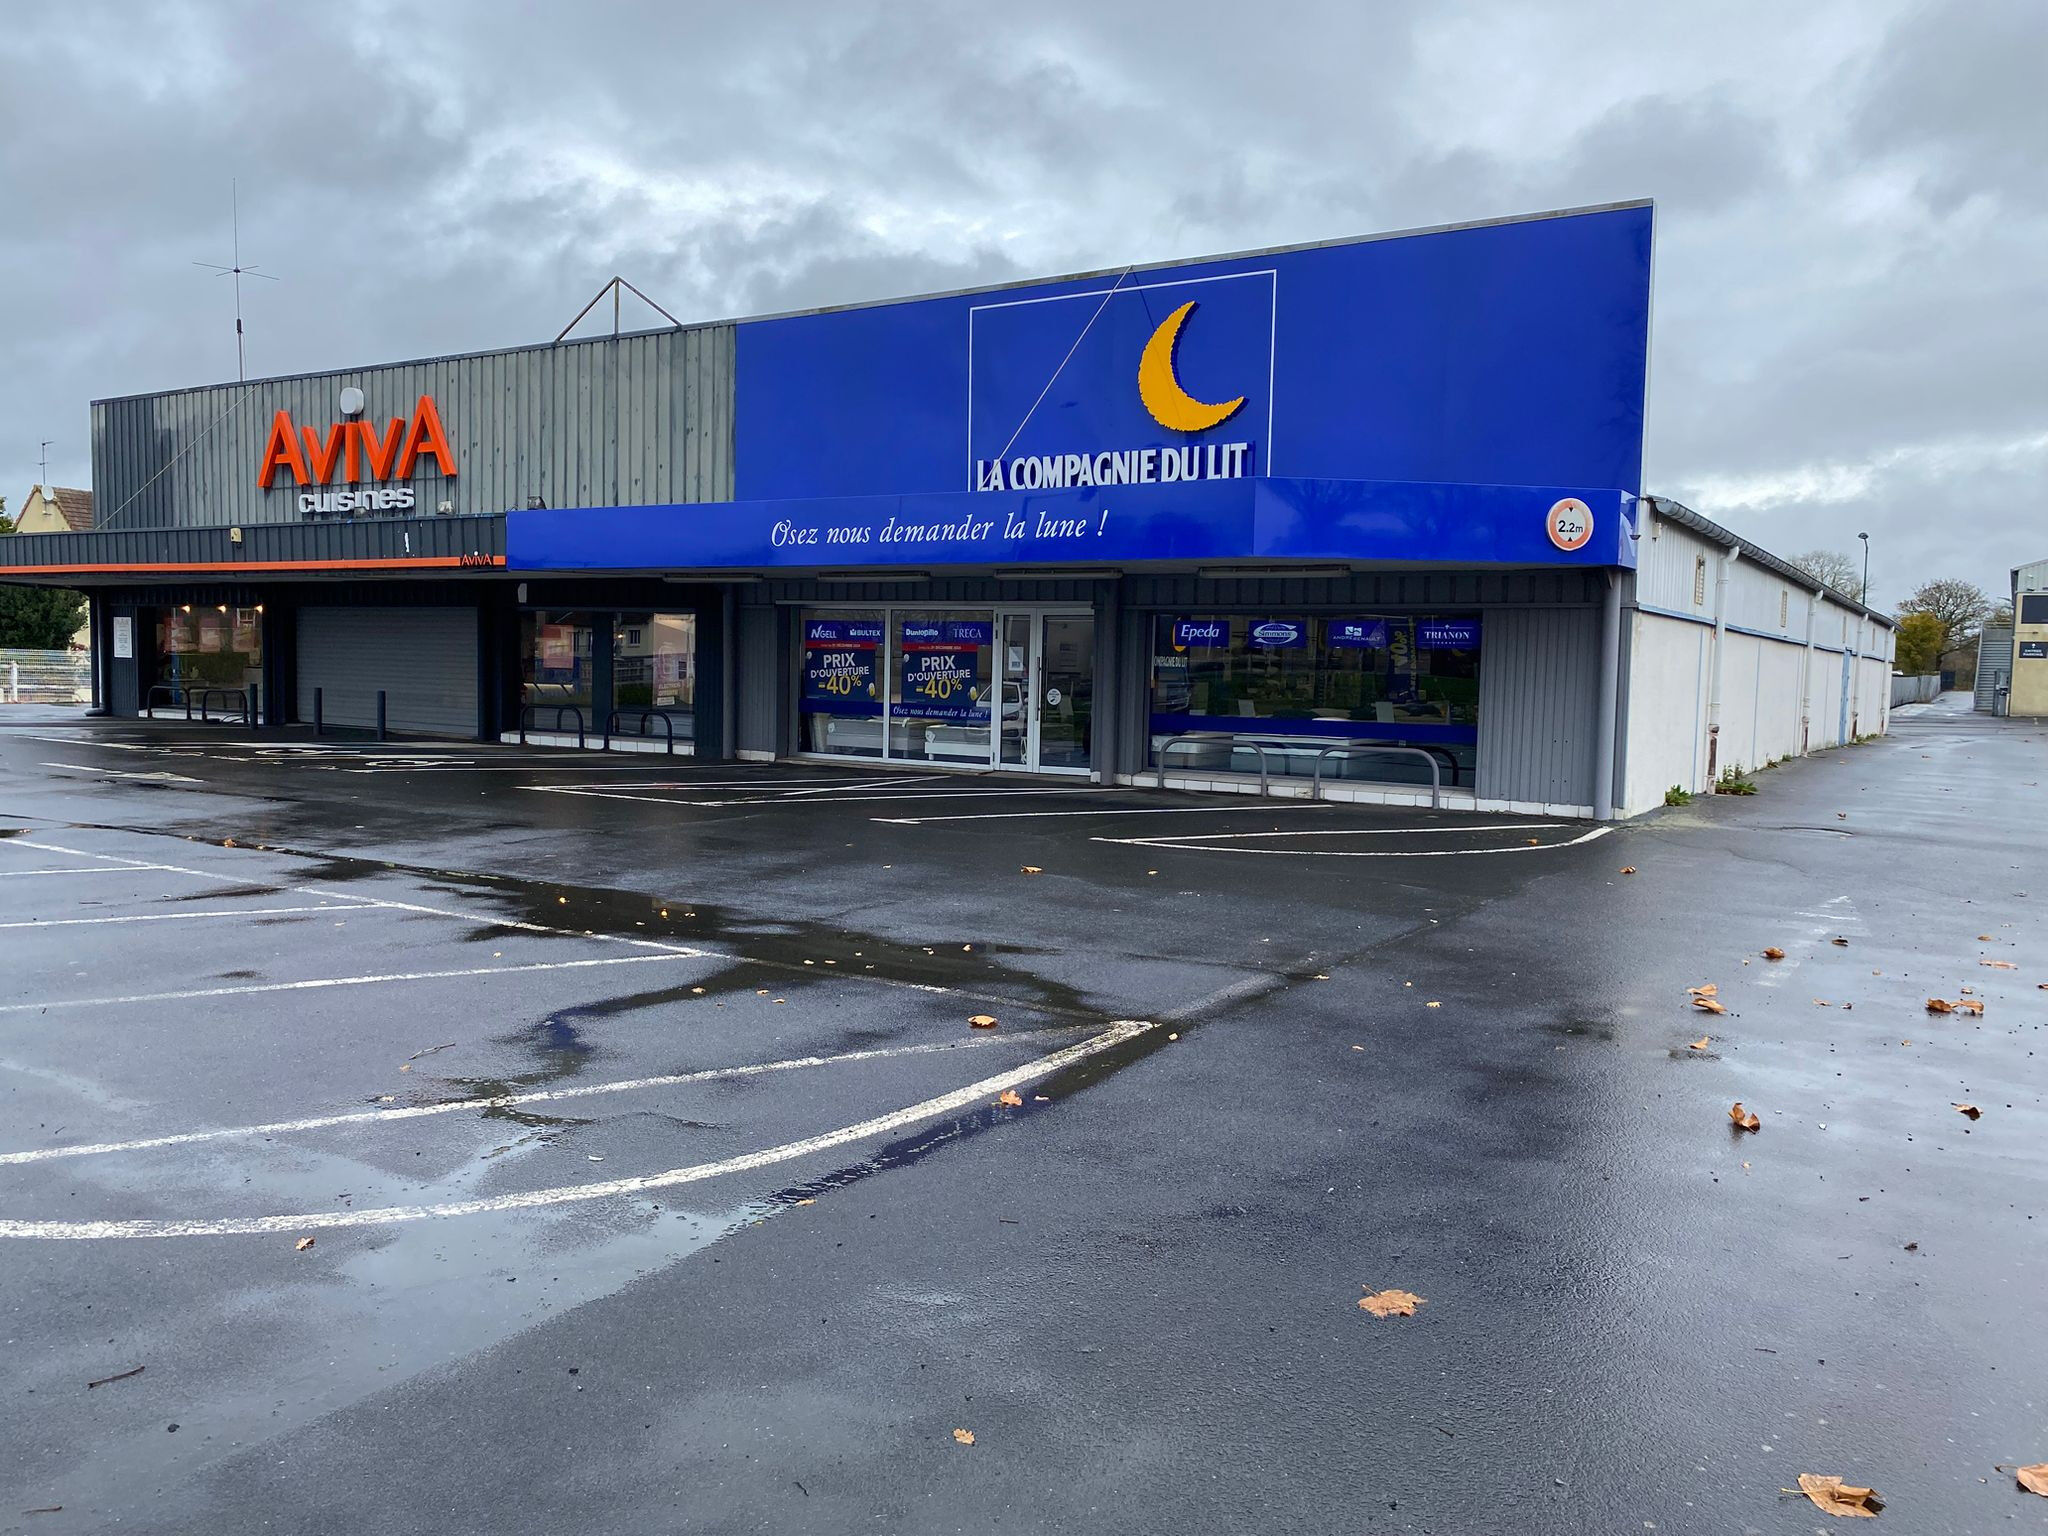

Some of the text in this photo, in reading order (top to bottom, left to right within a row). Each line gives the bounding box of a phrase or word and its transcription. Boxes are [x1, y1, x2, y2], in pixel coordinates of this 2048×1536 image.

[977, 442, 1248, 492] LA COMPAGNIE DU LIT
[299, 487, 415, 513] cuisines
[770, 509, 1109, 547] Osez nous demander la lune !
[857, 629, 881, 637] BULTEX
[953, 628, 982, 638] TRECA
[1180, 623, 1220, 641] Epeda
[1424, 631, 1470, 639] TRIANON
[823, 652, 856, 668] PRIX
[921, 655, 956, 671] PRIX
[810, 666, 870, 679] D'OUVERTURE
[907, 669, 971, 682] D'OUVERTURE
[893, 706, 908, 715] Osez
[925, 707, 958, 717] demander
[960, 708, 967, 717] la
[968, 709, 983, 718] lune
